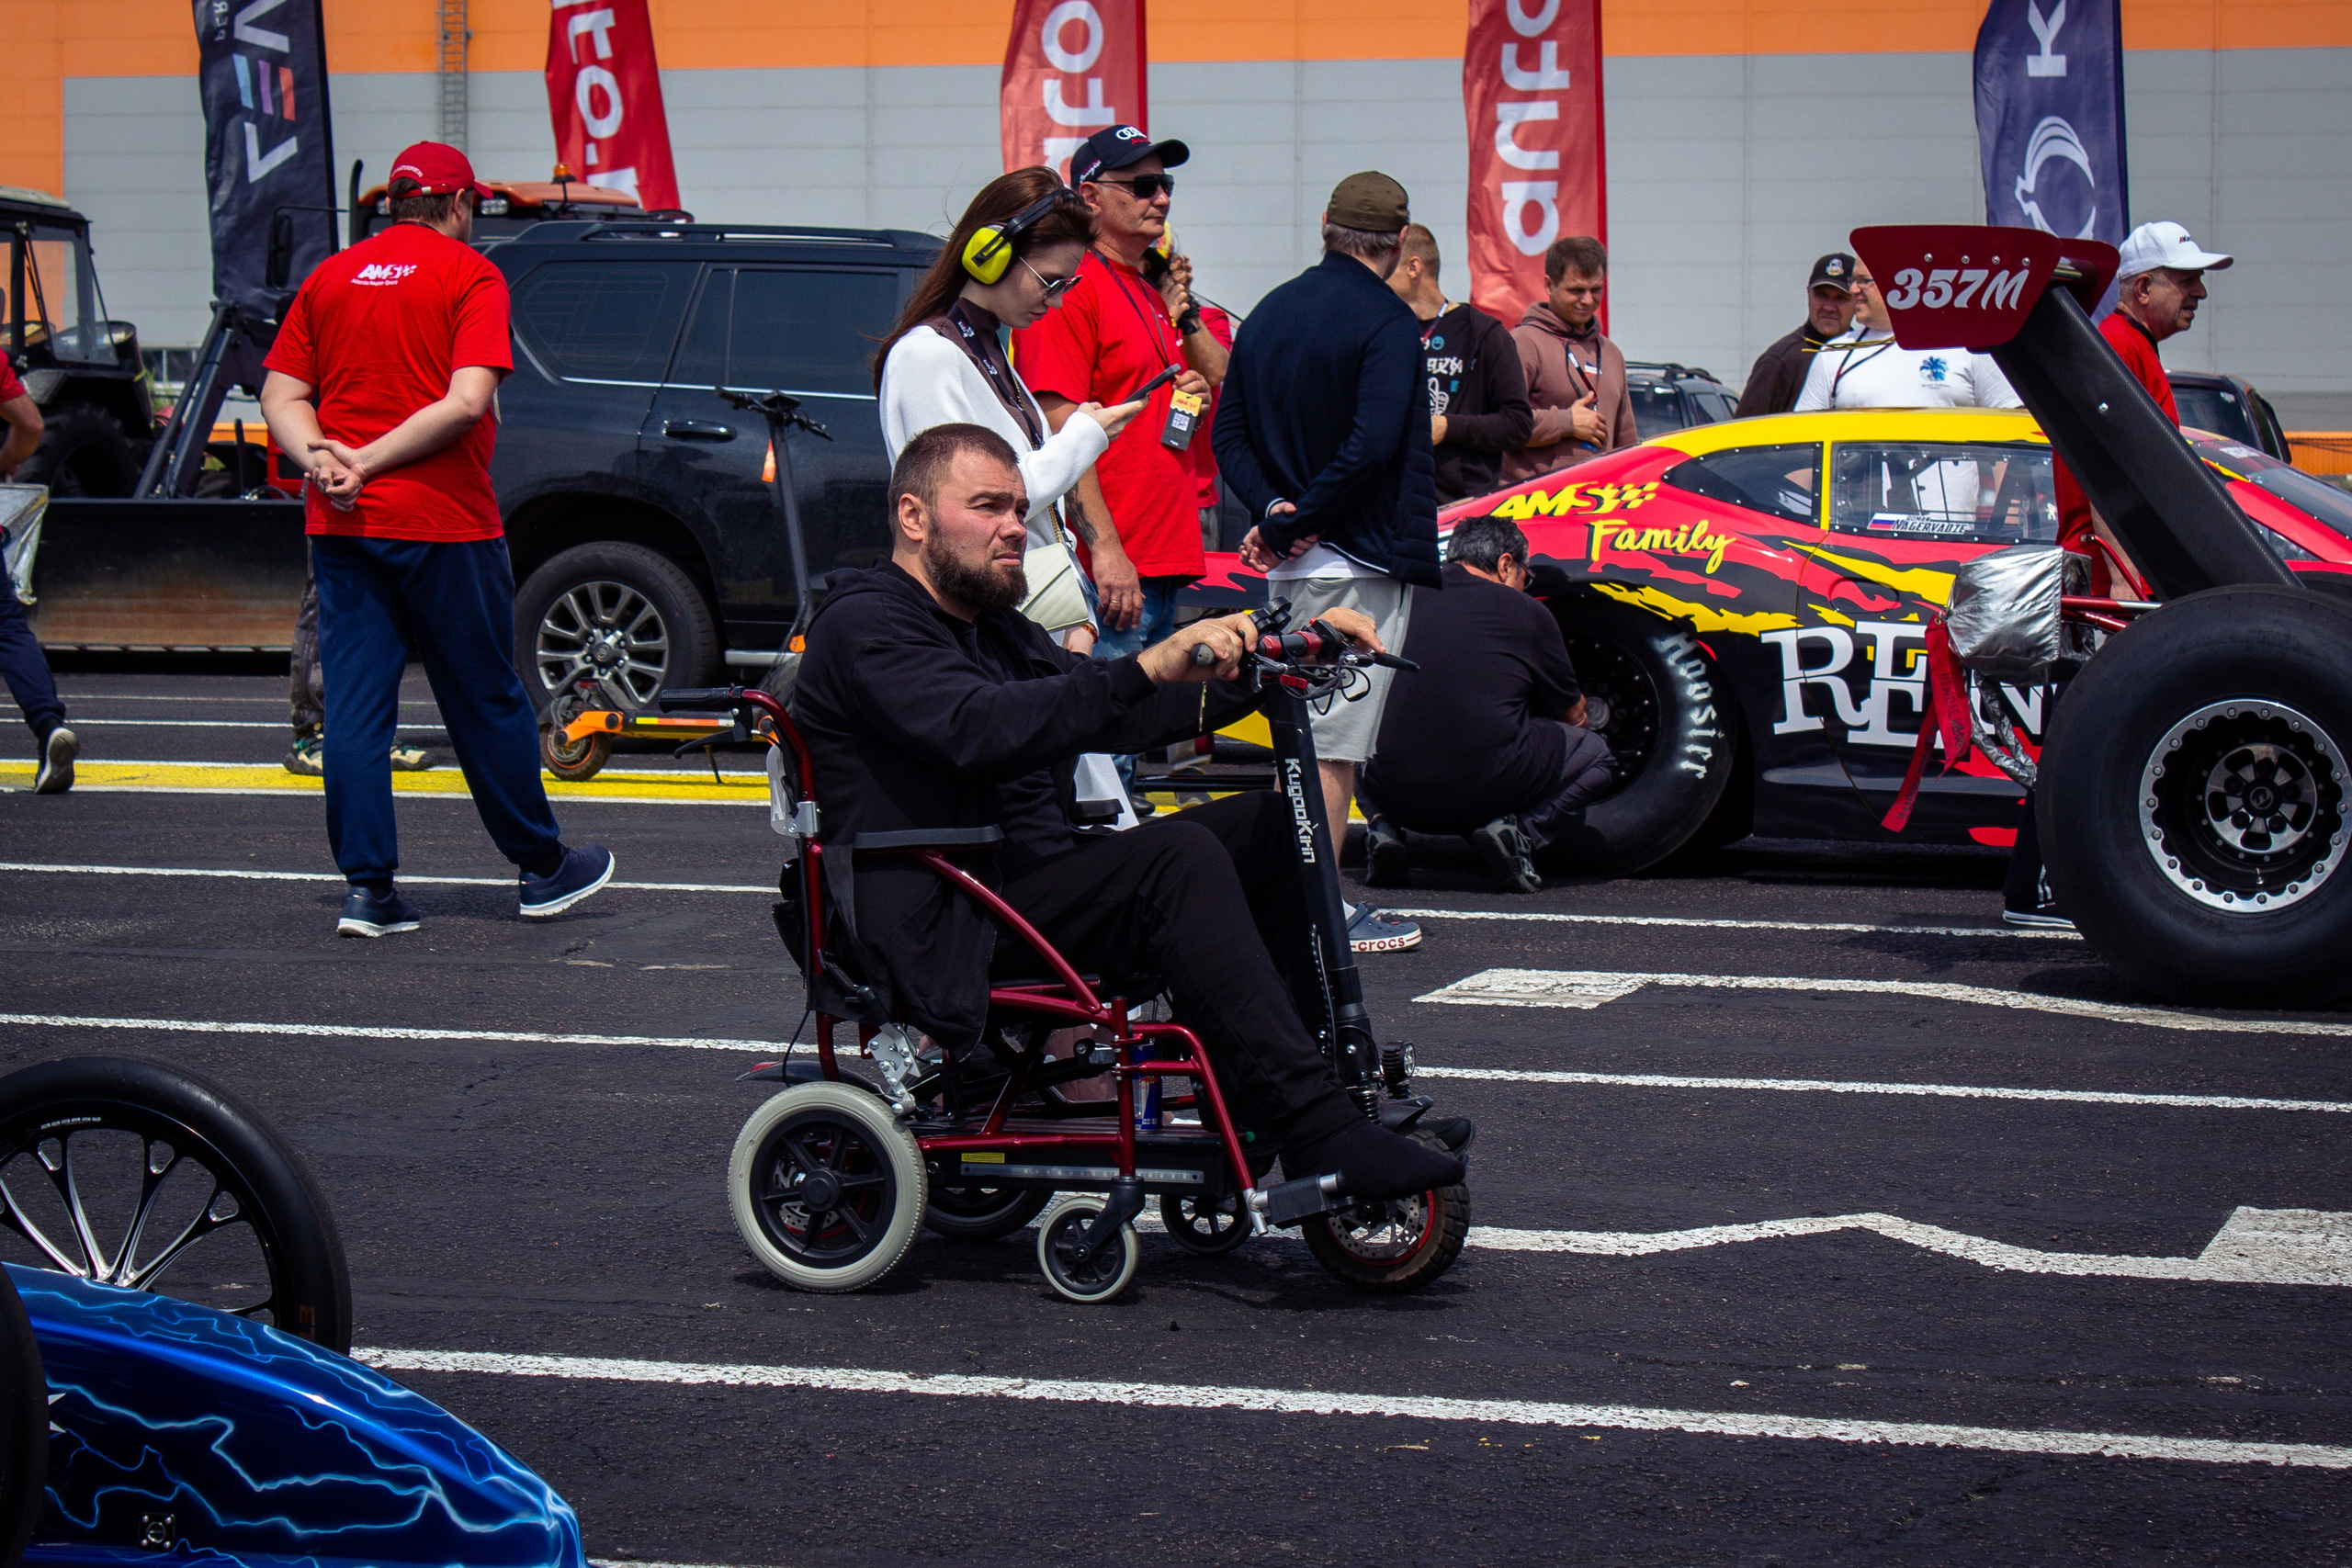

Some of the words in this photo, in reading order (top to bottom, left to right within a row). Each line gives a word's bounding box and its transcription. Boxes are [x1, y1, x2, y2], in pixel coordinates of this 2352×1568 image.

[1886, 268, 2030, 310] 357M
[1489, 482, 1625, 520] AMS
[1587, 519, 1736, 574] Family
[1654, 632, 1724, 779] Hoosier
[1358, 937, 1405, 951] crocs
